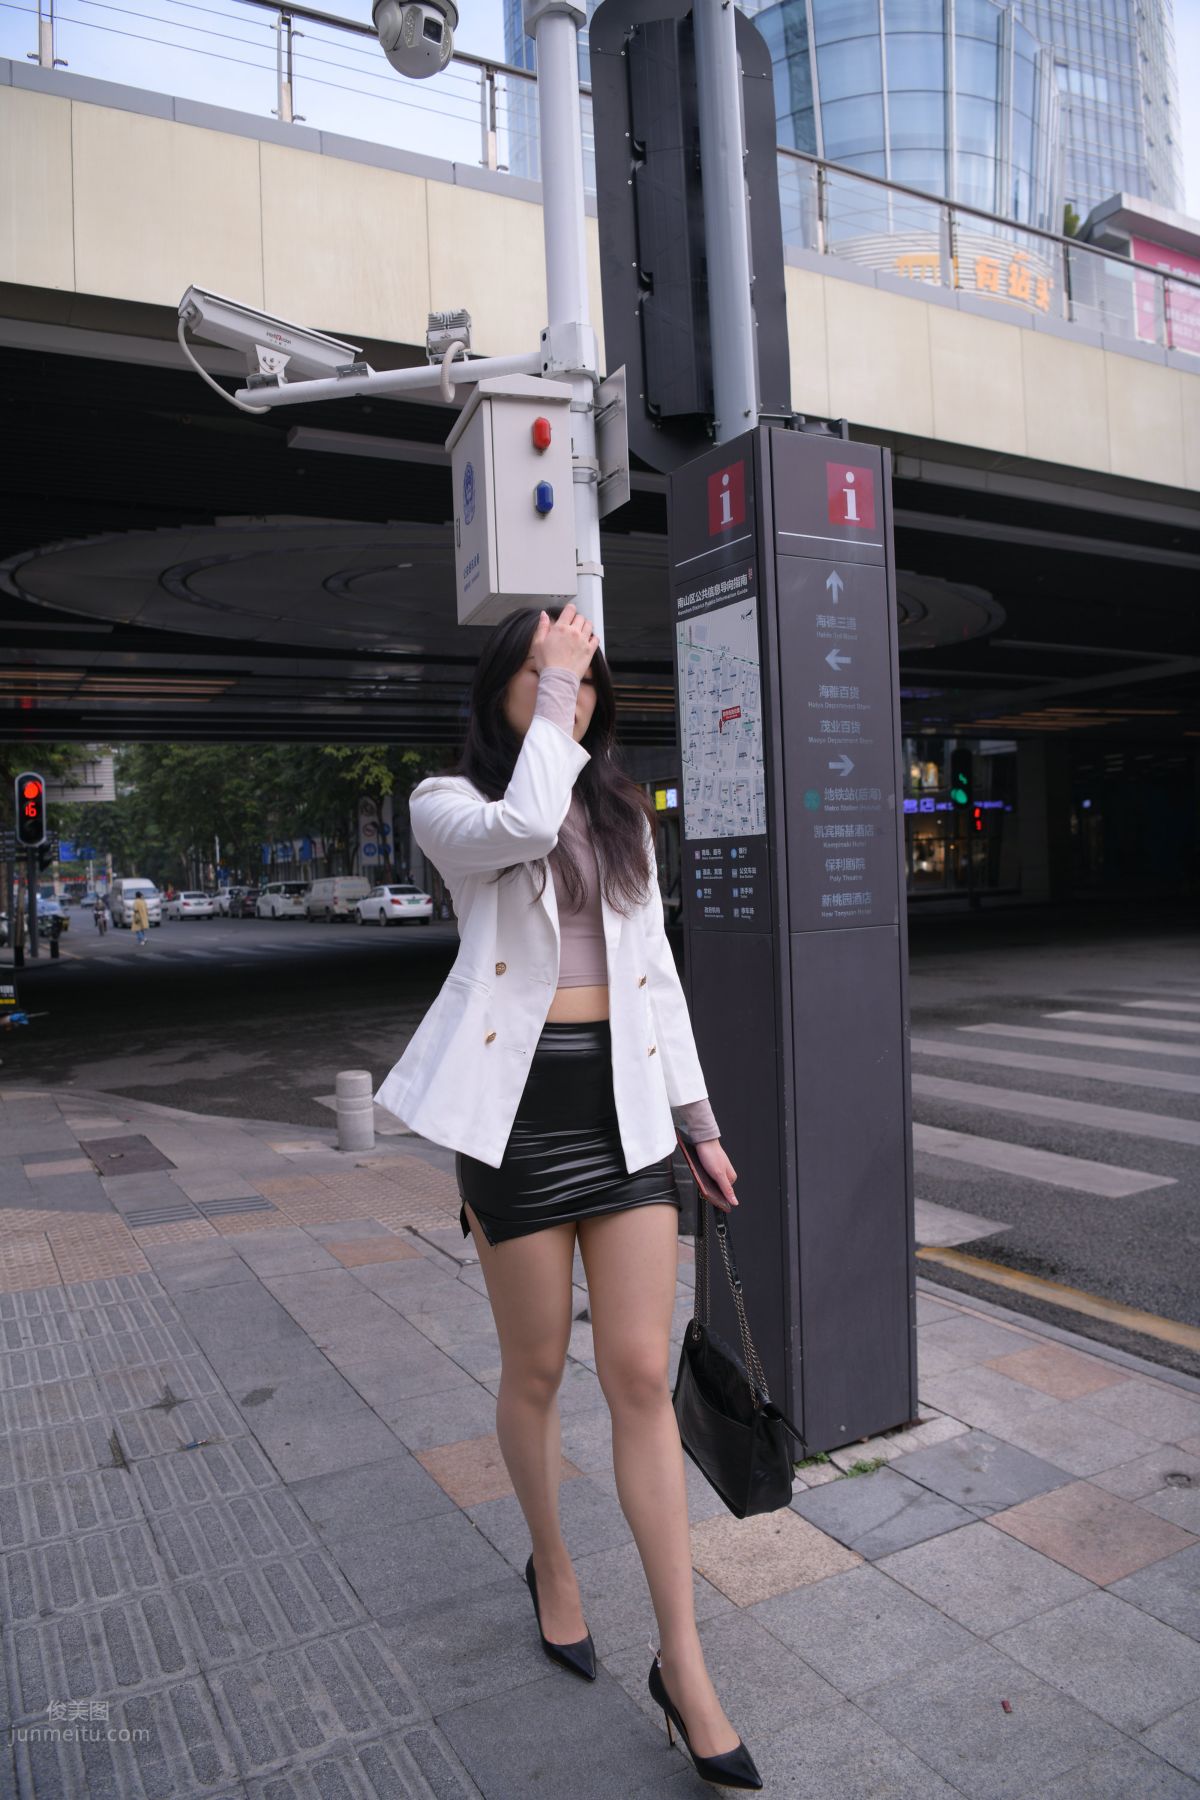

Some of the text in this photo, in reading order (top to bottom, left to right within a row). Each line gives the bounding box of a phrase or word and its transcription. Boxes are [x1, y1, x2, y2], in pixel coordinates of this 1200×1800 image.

[677, 574, 748, 610] 南山区公共信息导向指南
[818, 685, 860, 699] 海雅百货
[819, 720, 861, 734] 茂业百货
[814, 824, 875, 838] 凯宾斯基酒店
[825, 857, 866, 871] 保利剧院
[821, 892, 872, 907] 新桃园酒店
